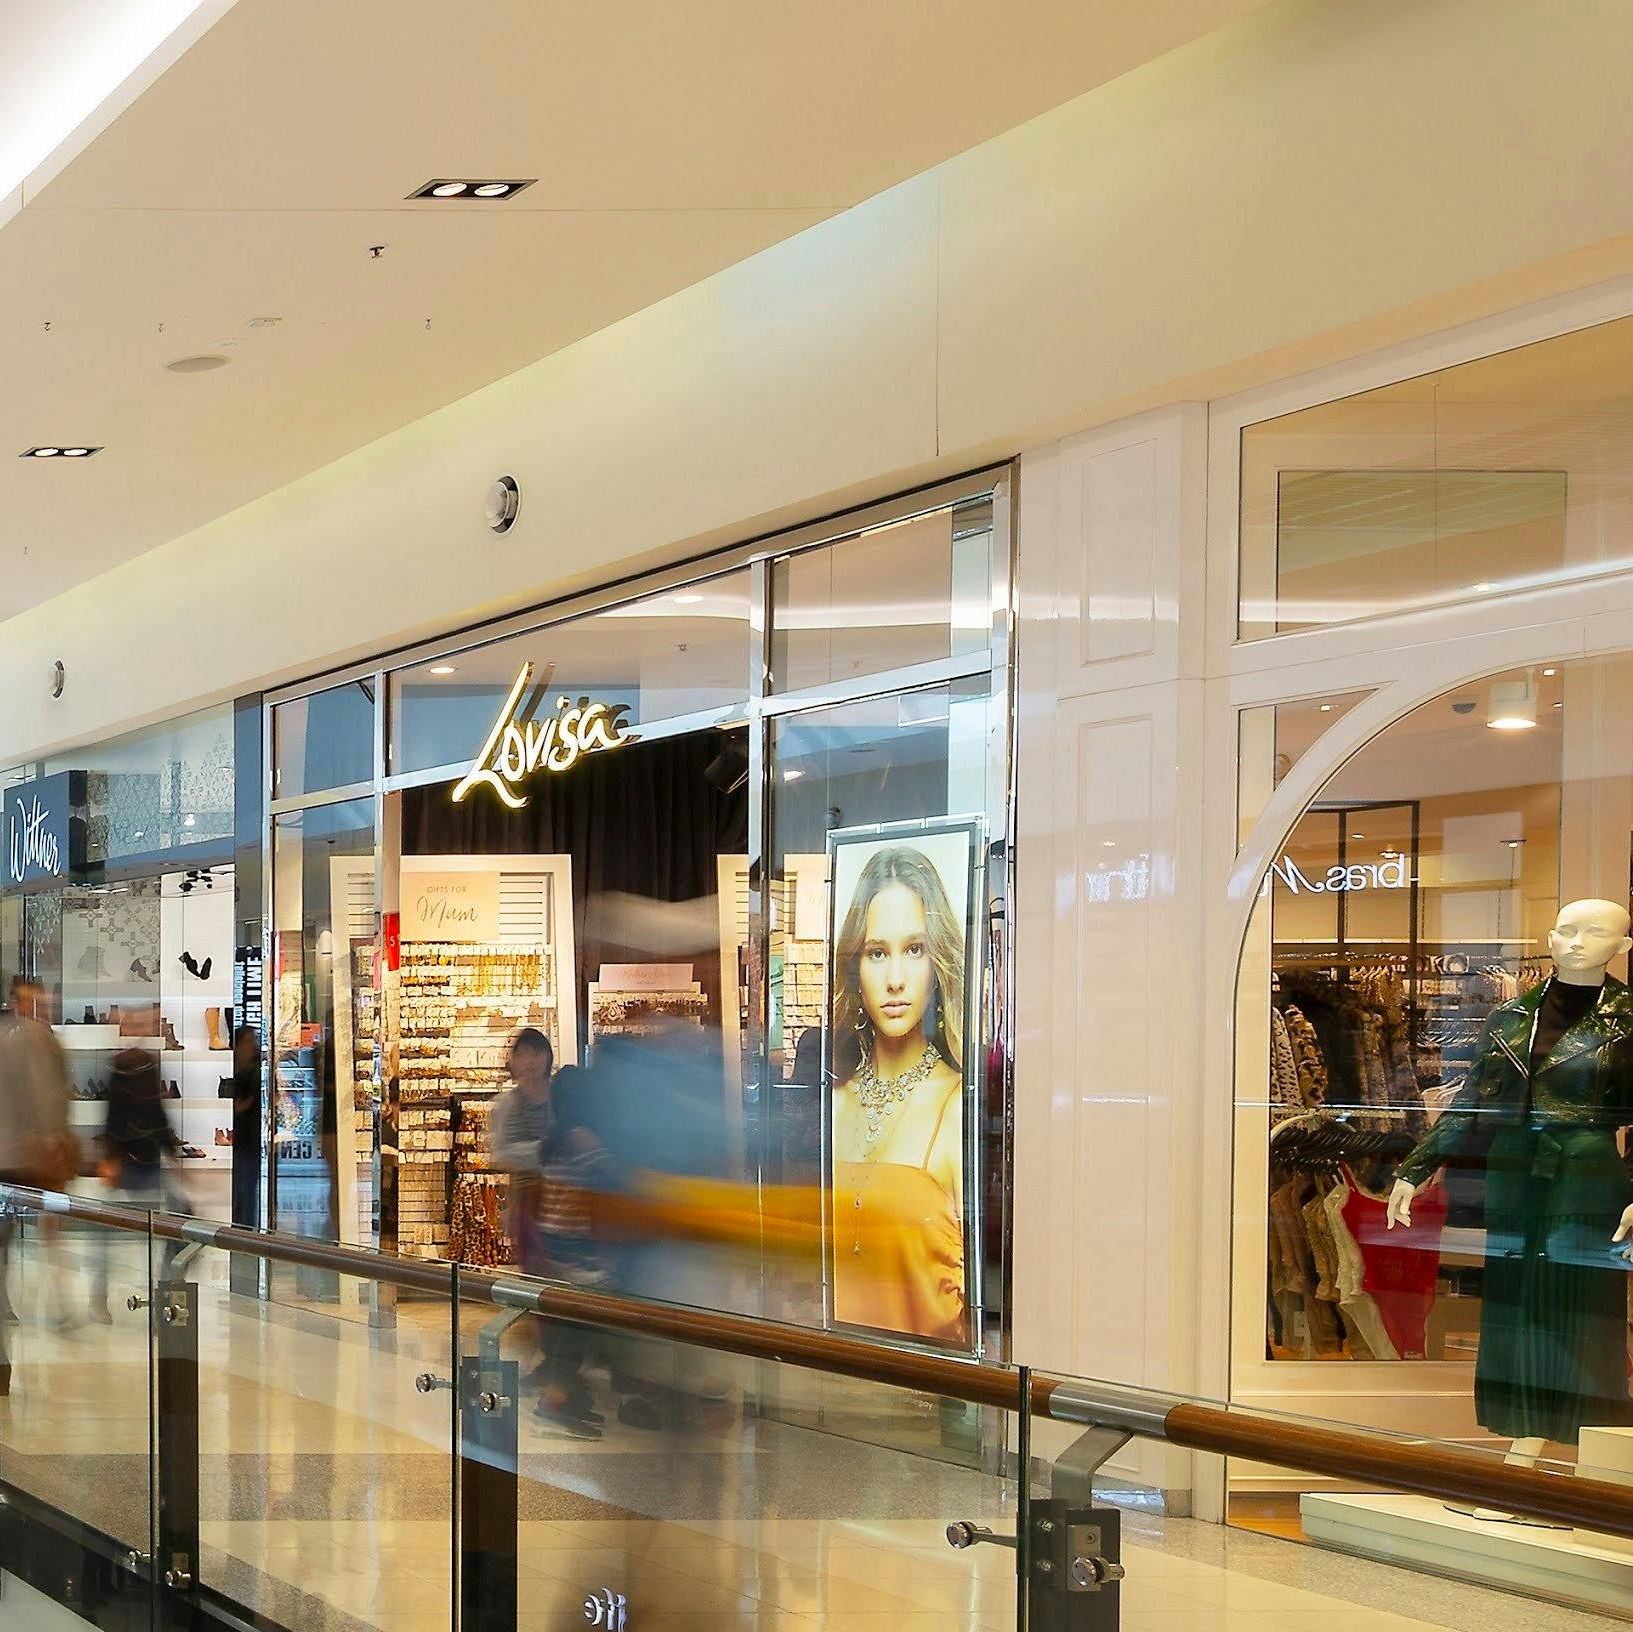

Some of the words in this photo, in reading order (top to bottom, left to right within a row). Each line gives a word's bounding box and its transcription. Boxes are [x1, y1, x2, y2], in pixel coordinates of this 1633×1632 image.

[450, 660, 627, 810] Lovisa
[10, 794, 62, 883] Wittner
[416, 895, 479, 929] Mum
